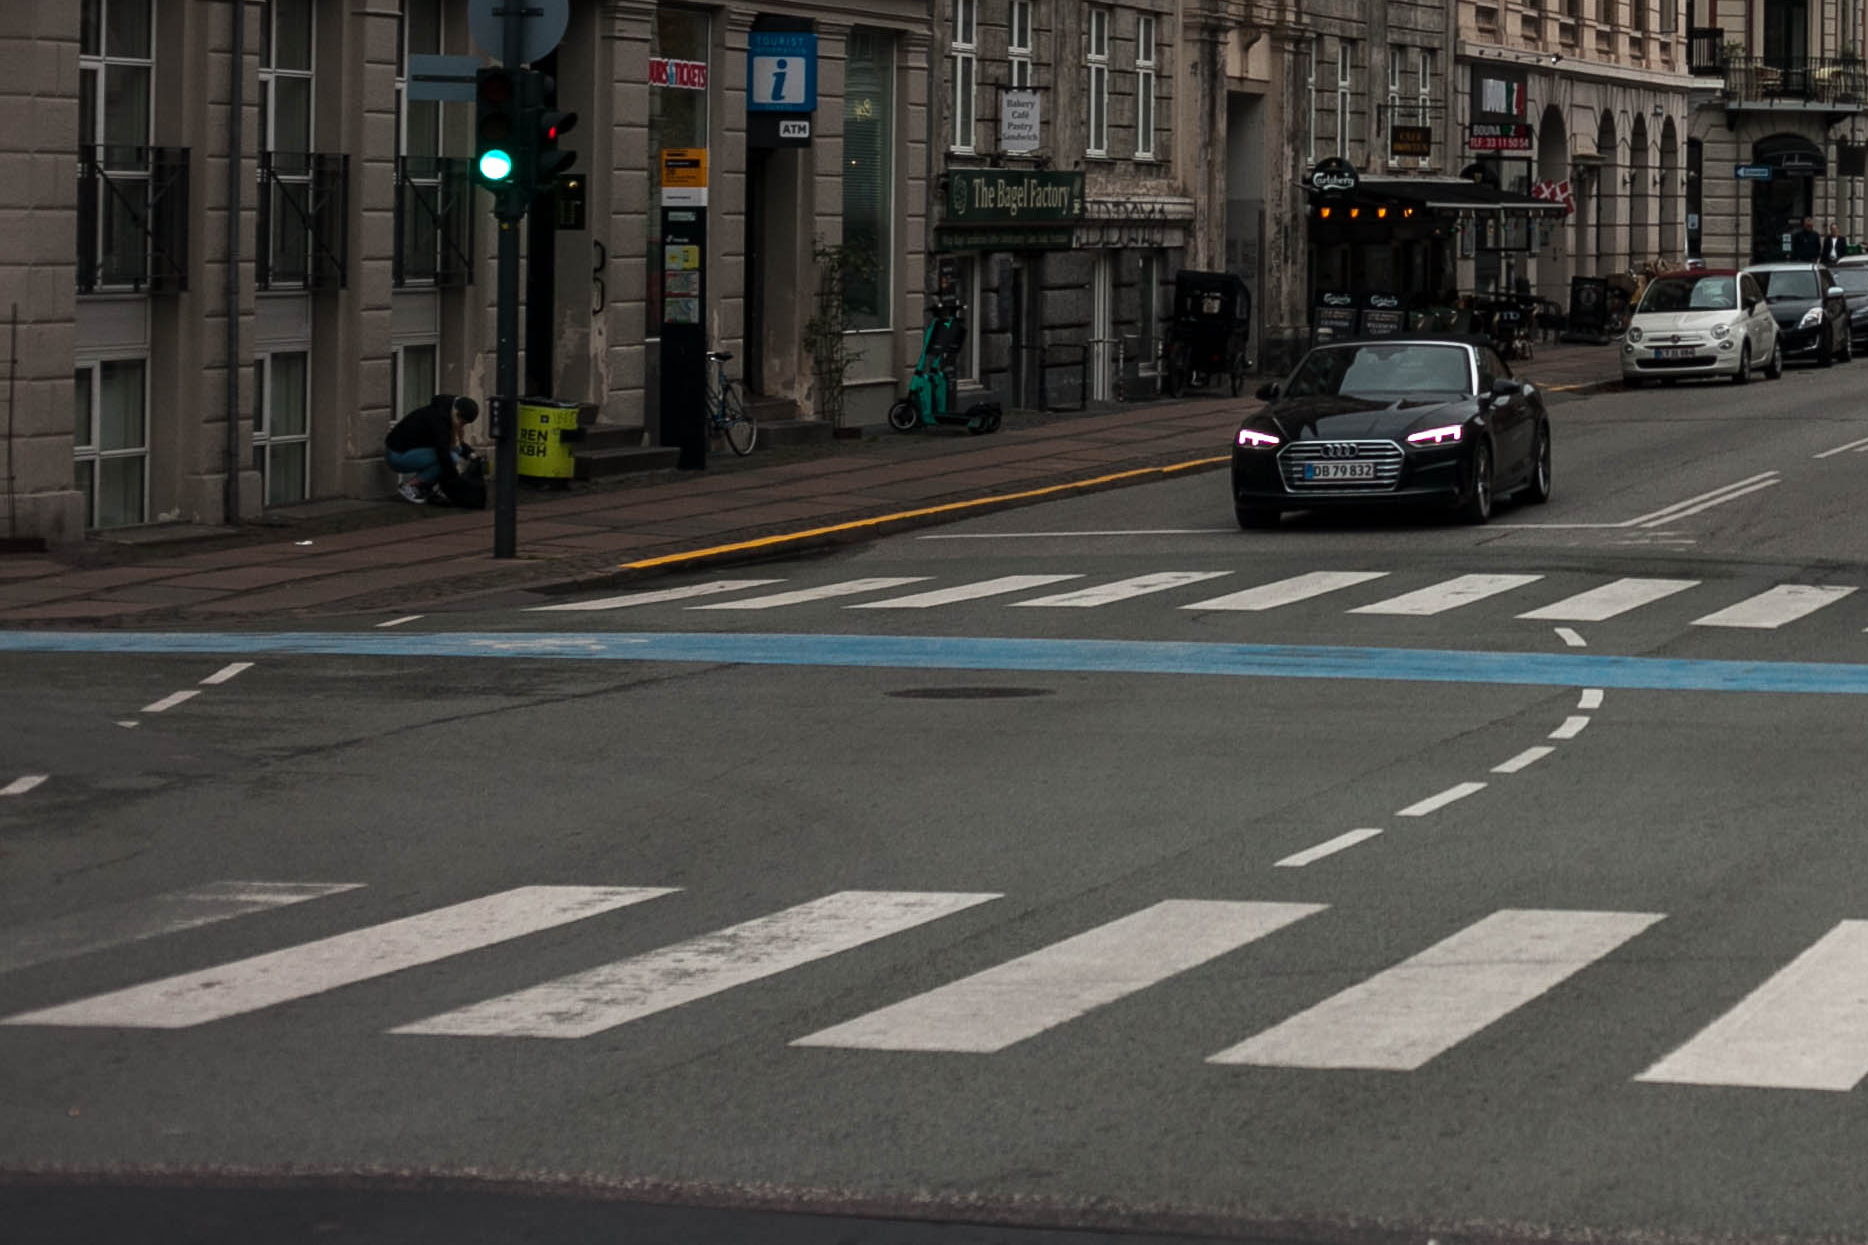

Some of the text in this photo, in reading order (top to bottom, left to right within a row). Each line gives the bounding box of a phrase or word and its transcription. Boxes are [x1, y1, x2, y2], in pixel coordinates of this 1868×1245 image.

[1006, 99, 1035, 109] Bakery
[782, 124, 807, 135] ATM
[1007, 122, 1033, 131] Pastry
[1002, 133, 1038, 141] Sandwich
[1312, 172, 1355, 190] Carlsberg
[972, 177, 995, 208] The
[997, 178, 1028, 216] Bagel
[1030, 179, 1070, 215] Factory
[520, 428, 548, 442] REN
[519, 445, 546, 457] KBH
[1313, 465, 1371, 477] DB 79 832
